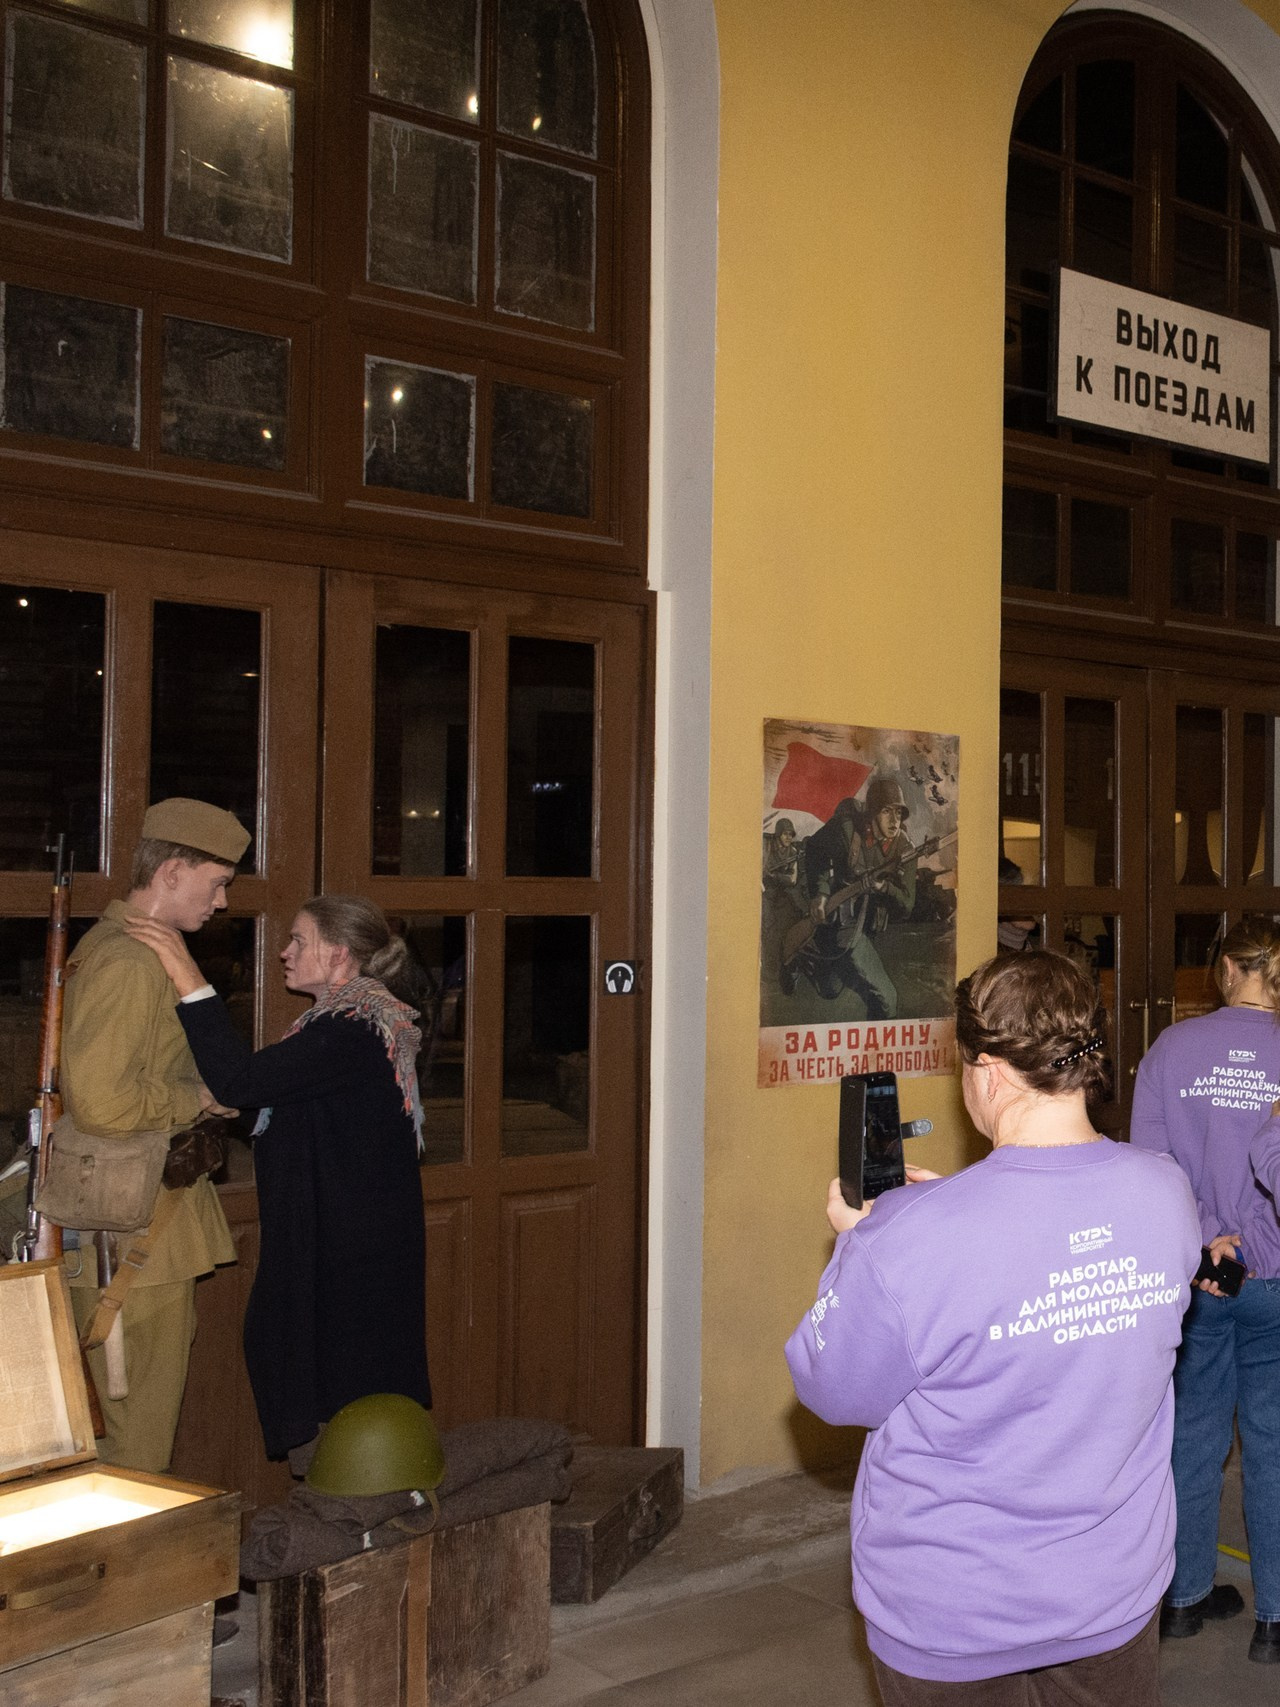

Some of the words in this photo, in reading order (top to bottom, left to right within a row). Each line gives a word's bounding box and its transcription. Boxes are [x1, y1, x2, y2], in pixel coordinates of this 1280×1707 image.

[1116, 307, 1221, 375] ВЫХОД
[1075, 354, 1094, 395] К
[1114, 364, 1255, 434] ПОЕЗДАМ
[785, 1031, 818, 1054] ЗА
[828, 1023, 938, 1052] РОДИНУ,
[769, 1060, 790, 1083] ЗА
[851, 1053, 870, 1075] ЗА
[876, 1048, 947, 1074] СВОБОДУ!
[1194, 1076, 1216, 1087] ДЛЯ
[1212, 1066, 1266, 1080] РАБОТАЮ
[1180, 1088, 1187, 1098] В
[1189, 1086, 1280, 1104] КАЛИНИНГРАДСК
[1211, 1097, 1261, 1112] ОБЛАСТИ
[1049, 1256, 1137, 1288] РАБОТАЮ
[1019, 1293, 1056, 1318] ДЛЯ
[1061, 1271, 1165, 1305] МОЛОДЁЖИ
[989, 1324, 1003, 1340] В
[1008, 1284, 1181, 1338] КАЛИНИНГРАДСКОЙ
[1053, 1313, 1138, 1345] ОБЛАСТИ
